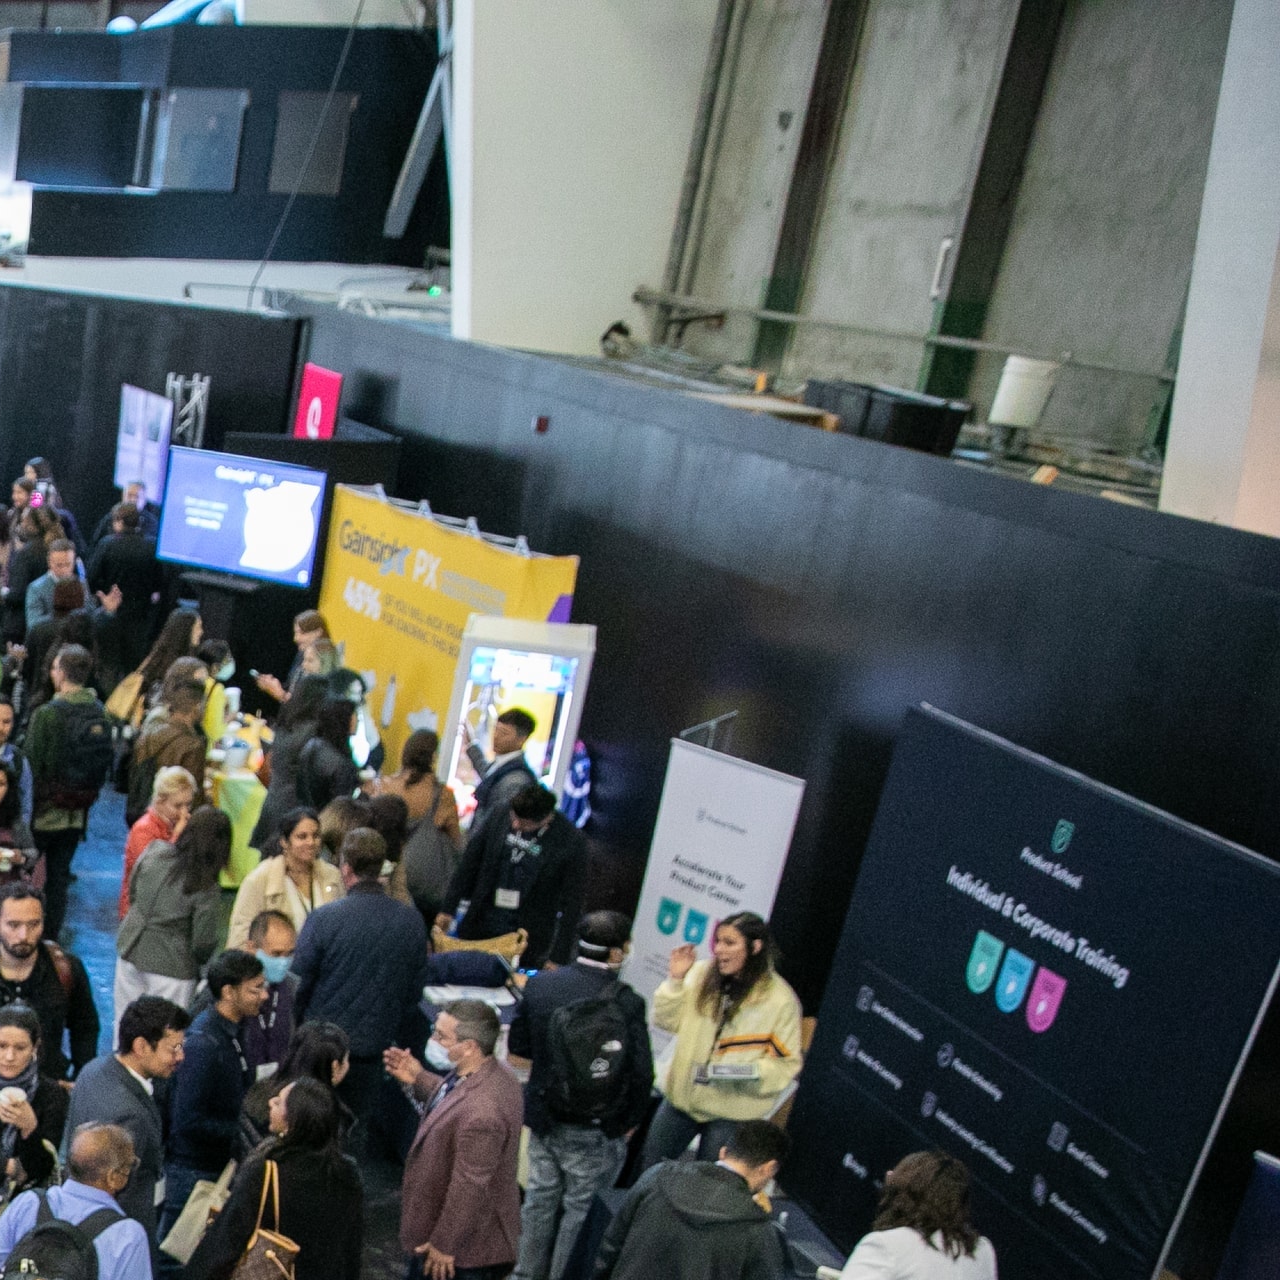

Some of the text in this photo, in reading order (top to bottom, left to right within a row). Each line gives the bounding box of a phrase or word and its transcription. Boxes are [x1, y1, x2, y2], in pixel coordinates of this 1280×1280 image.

[412, 548, 441, 591] PX
[946, 865, 1130, 989] Individual & Corporate Training
